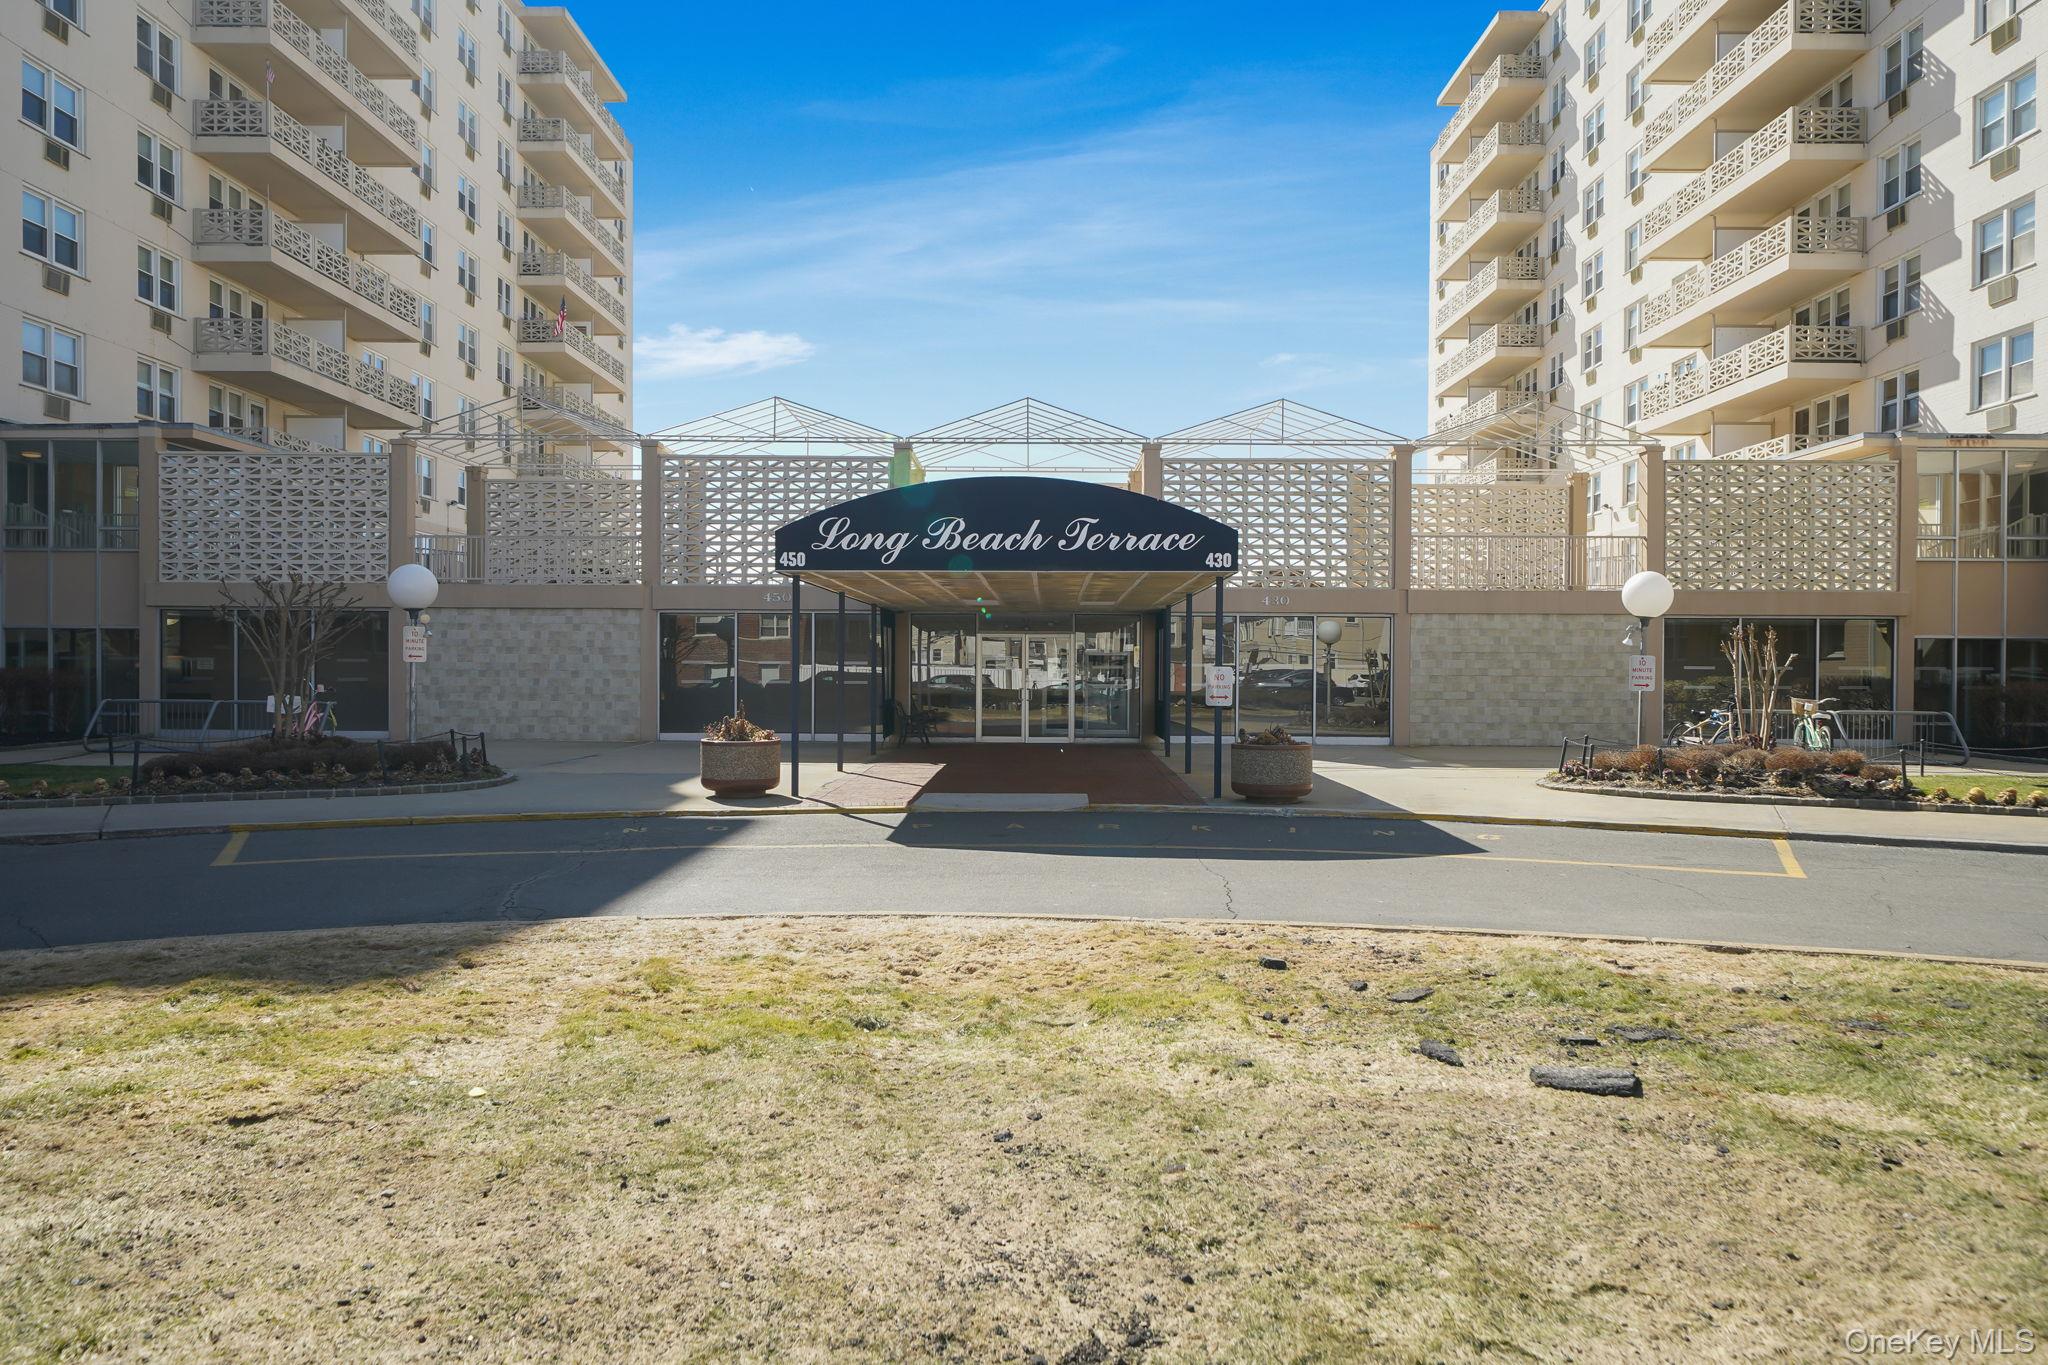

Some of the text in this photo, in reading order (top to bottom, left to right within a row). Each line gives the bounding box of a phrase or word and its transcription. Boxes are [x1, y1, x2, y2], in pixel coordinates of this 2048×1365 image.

[811, 516, 1205, 565] Long Beach Terrace
[779, 552, 806, 567] 450
[1205, 552, 1232, 568] 430
[762, 592, 791, 602] 450
[1261, 596, 1290, 606] 430
